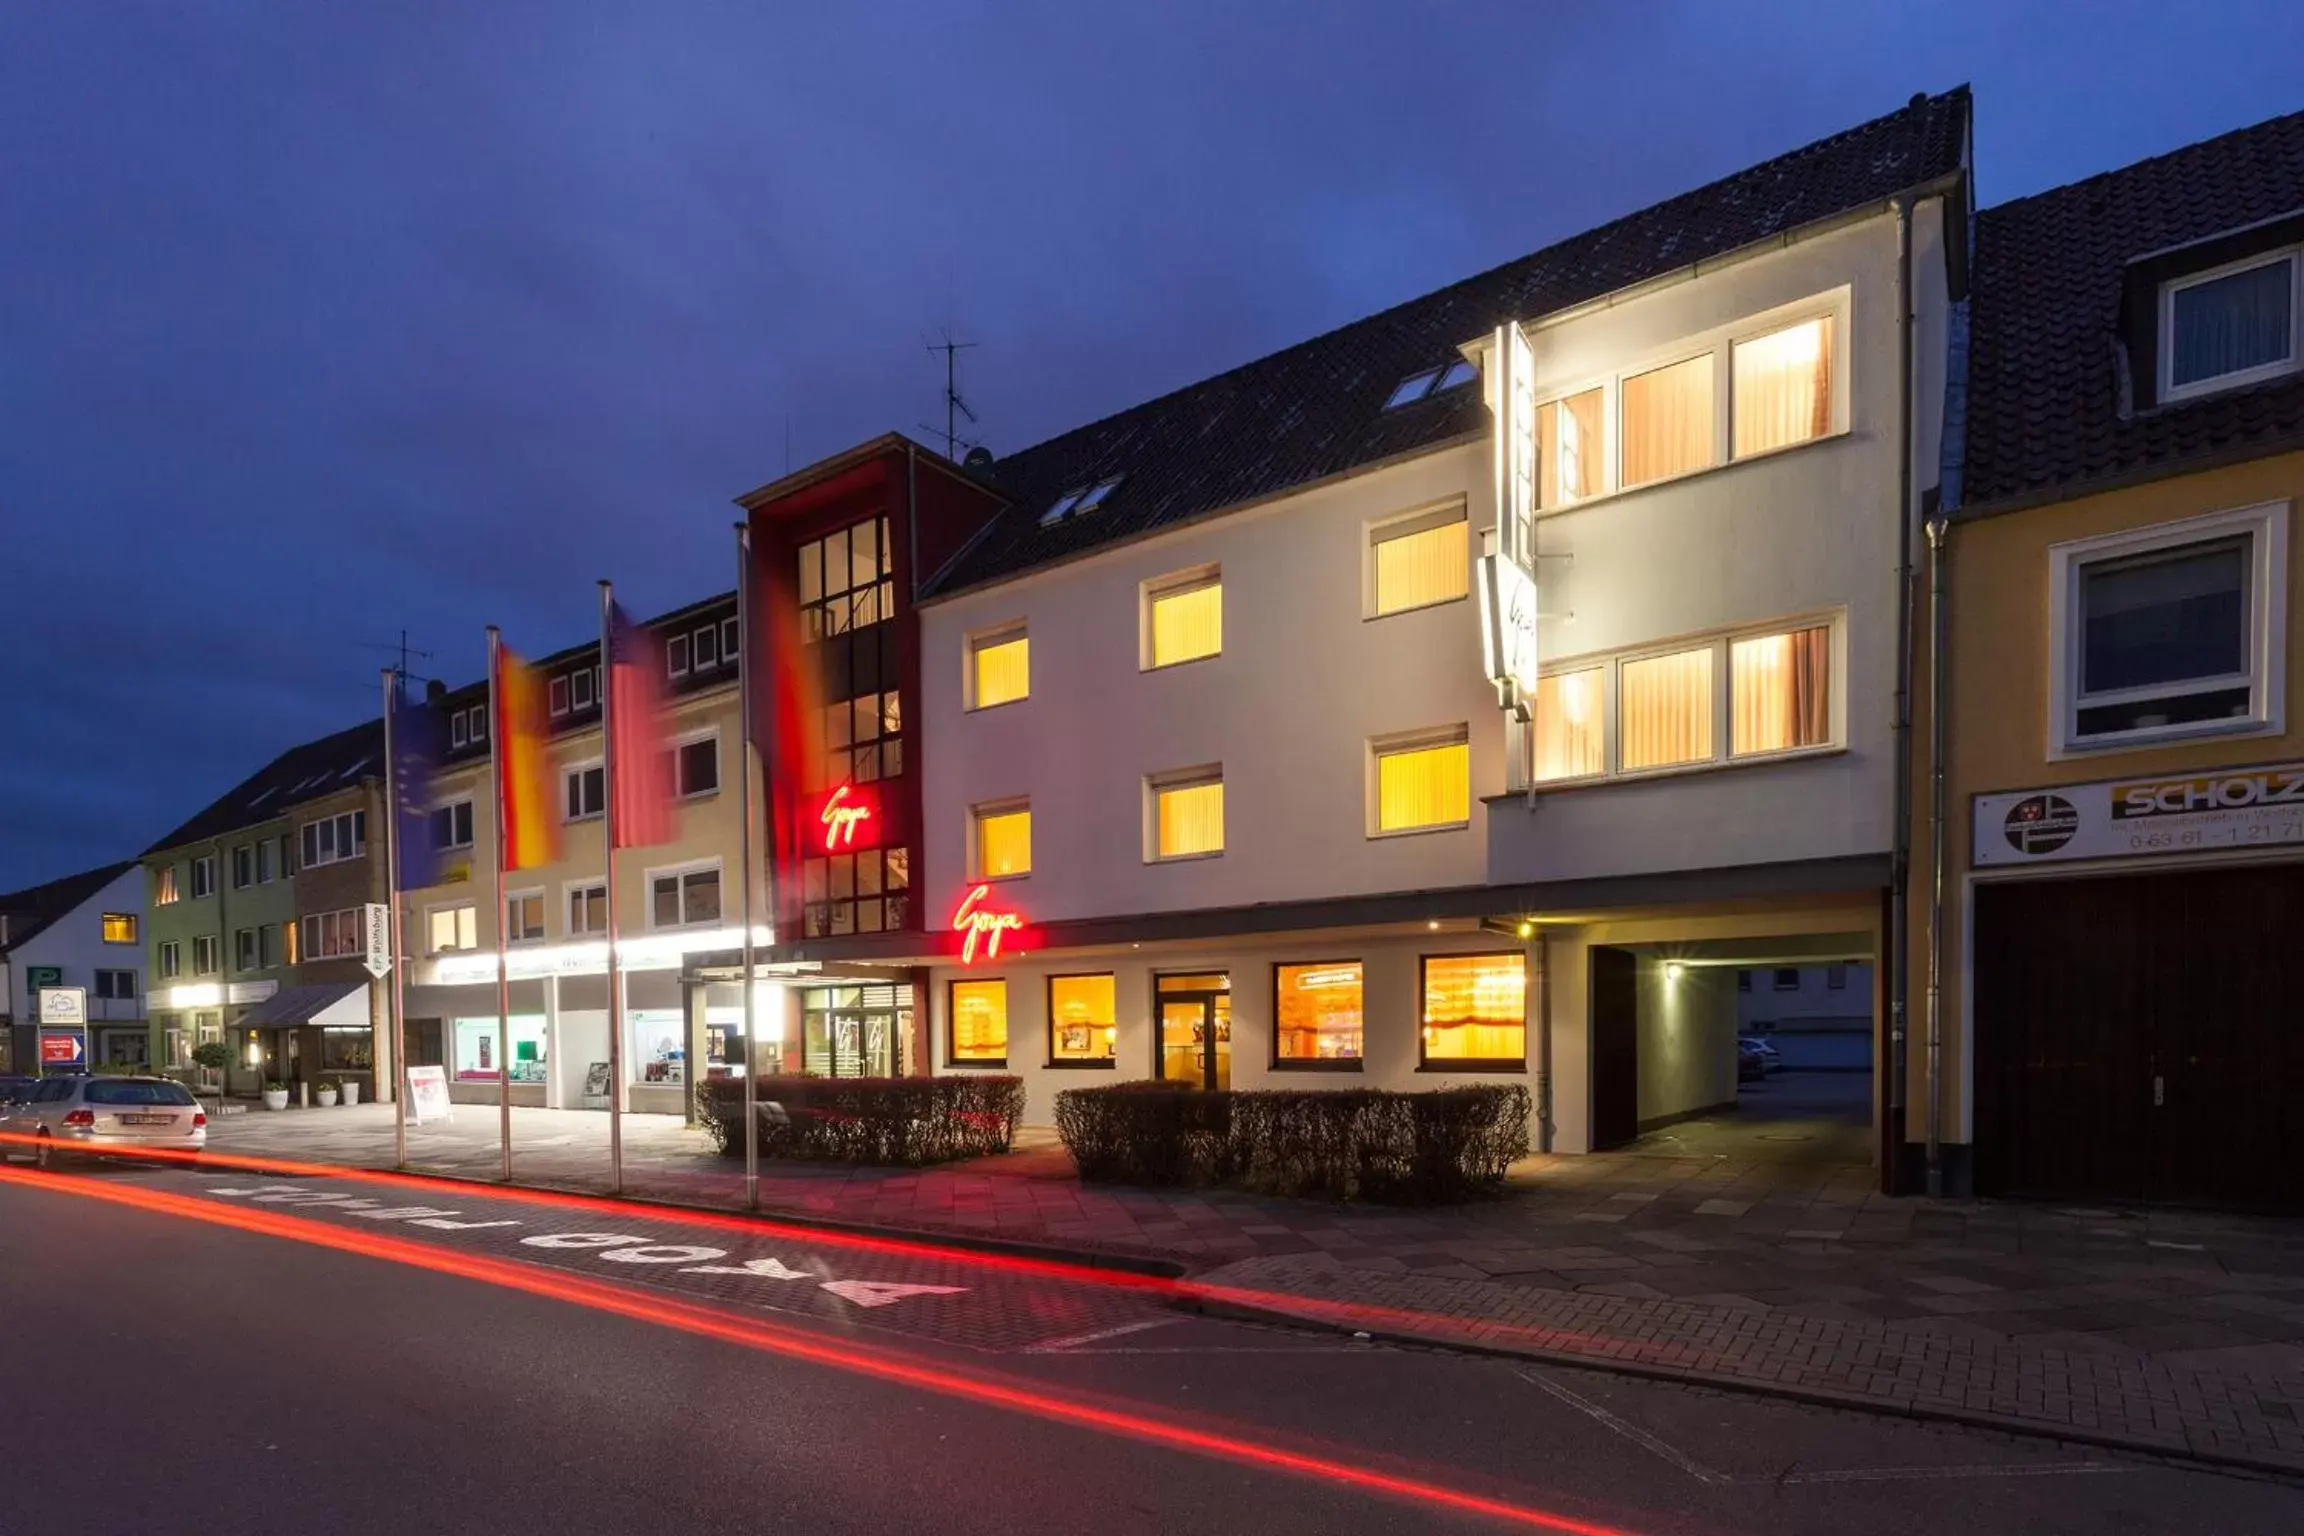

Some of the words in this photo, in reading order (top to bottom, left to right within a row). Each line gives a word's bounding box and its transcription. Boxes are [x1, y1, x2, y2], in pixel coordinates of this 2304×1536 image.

[822, 786, 870, 849] Goya
[2125, 773, 2304, 815] SCHOLZ
[953, 885, 1023, 965] Goya
[519, 1232, 969, 1308] GOYA
